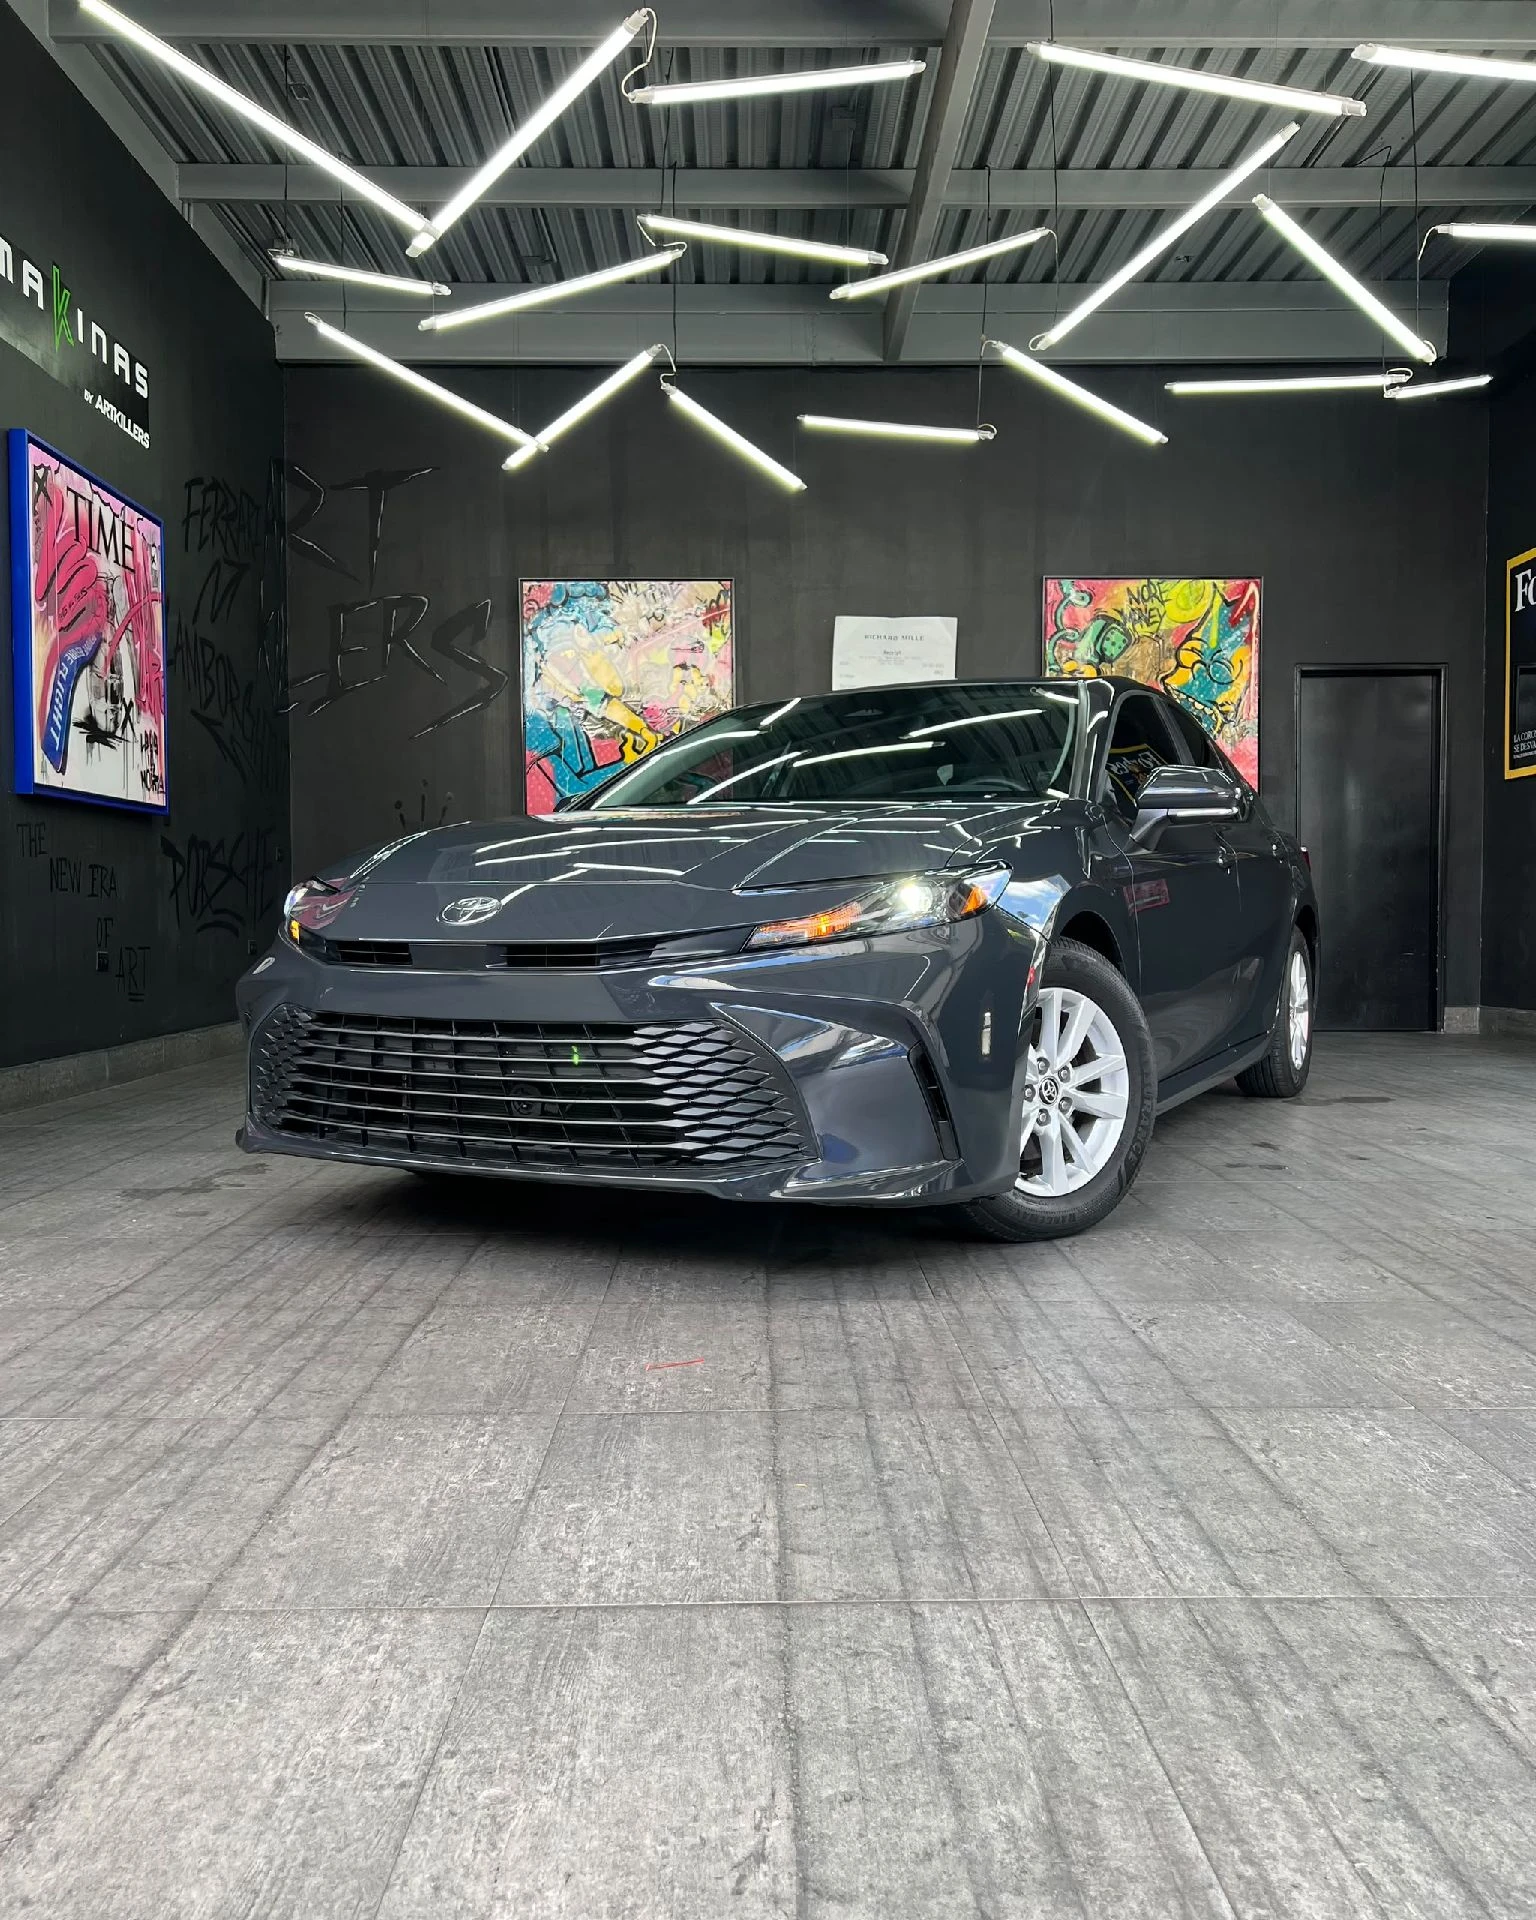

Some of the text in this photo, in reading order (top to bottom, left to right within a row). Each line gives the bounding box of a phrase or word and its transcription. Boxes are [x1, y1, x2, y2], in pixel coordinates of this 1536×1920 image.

[95, 395, 150, 449] ARTKILLERS
[66, 486, 136, 575] TIME
[50, 662, 69, 752] FLIGHT
[16, 822, 48, 857] THE
[49, 857, 119, 899] NEW ERA
[114, 945, 151, 993] ART
